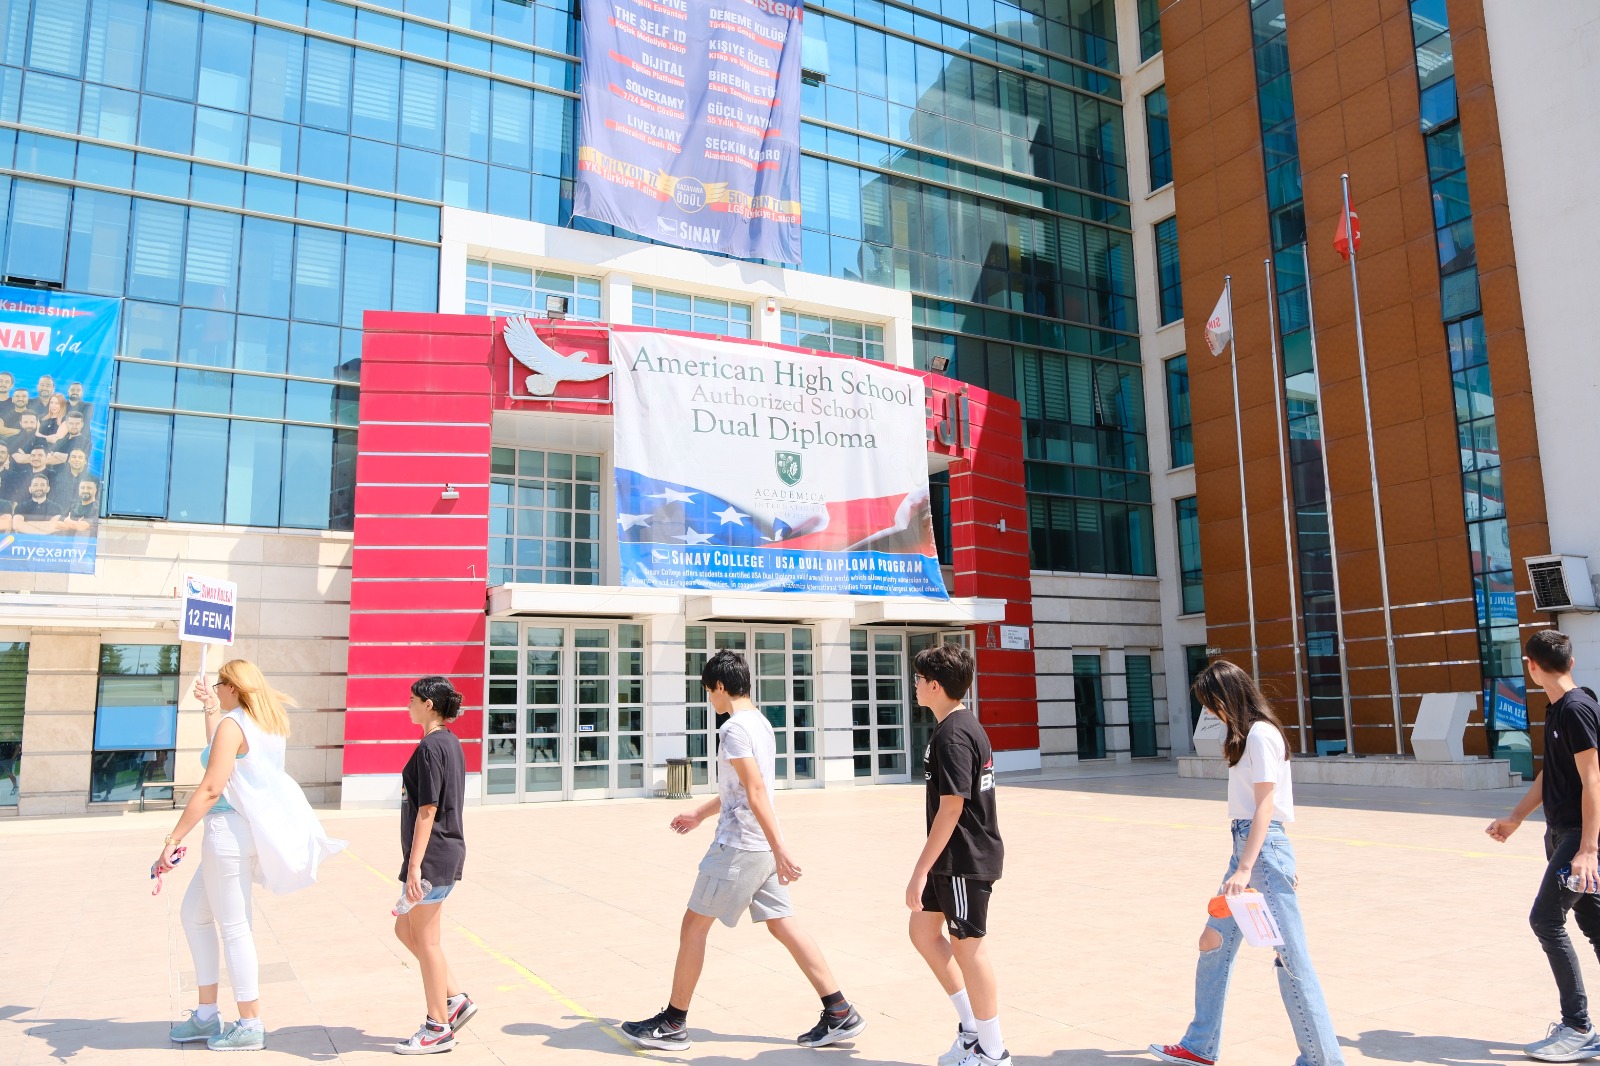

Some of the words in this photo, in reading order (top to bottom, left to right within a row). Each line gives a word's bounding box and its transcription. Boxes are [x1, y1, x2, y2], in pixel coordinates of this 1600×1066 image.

[709, 8, 752, 29] DENEME
[744, 0, 798, 20] stem
[615, 5, 637, 26] THE
[640, 18, 670, 38] SELF
[673, 28, 687, 43] ID
[709, 20, 736, 32] Türkiye
[668, 42, 686, 54] Takip
[747, 48, 770, 69] ÖZEL
[709, 52, 729, 62] Kitap
[730, 56, 738, 64] ve
[739, 60, 770, 77] Uygulama
[652, 71, 685, 87] Platformu
[623, 92, 639, 105] 7/24
[639, 98, 655, 111] Soru
[625, 78, 685, 109] SOLVEXAMY
[708, 82, 728, 94] Eksik
[730, 87, 769, 106] Tamamlama
[754, 85, 776, 98] ETÜ
[708, 101, 743, 121] GÜÇLÜ
[627, 114, 682, 144] LIVEXAMY
[667, 143, 682, 154] Ders
[585, 160, 602, 175] YKS
[602, 168, 635, 188] Türkiye
[637, 181, 657, 199] 1.sine
[648, 171, 658, 187] TL
[676, 190, 702, 207] ÖDÜL
[728, 191, 748, 206] 500
[772, 200, 783, 213] TL
[727, 204, 743, 215] LGS
[680, 221, 721, 244] SINAV
[631, 346, 765, 383] American
[774, 360, 833, 396] High
[841, 370, 914, 406] School
[691, 384, 805, 414] Authorized
[811, 397, 875, 421] School
[691, 408, 759, 438] Dual
[768, 416, 877, 450] Diploma
[754, 488, 824, 502] ACADEMICA
[11, 545, 87, 560] myexamy
[671, 550, 711, 566] SINAV
[714, 551, 765, 568] COLLEGE
[775, 556, 794, 569] USA
[799, 557, 823, 571] DUAL
[826, 558, 875, 572] DIPLOMA
[878, 558, 922, 573] PROGRAM
[661, 569, 681, 578] College
[699, 570, 723, 578] students
[729, 571, 751, 579] certified
[763, 572, 774, 580] Dual
[775, 573, 796, 581] Diploma
[825, 574, 833, 582] the
[835, 574, 849, 582] world
[188, 608, 200, 627] 12
[202, 610, 222, 630] FEN
[223, 614, 231, 631] A
